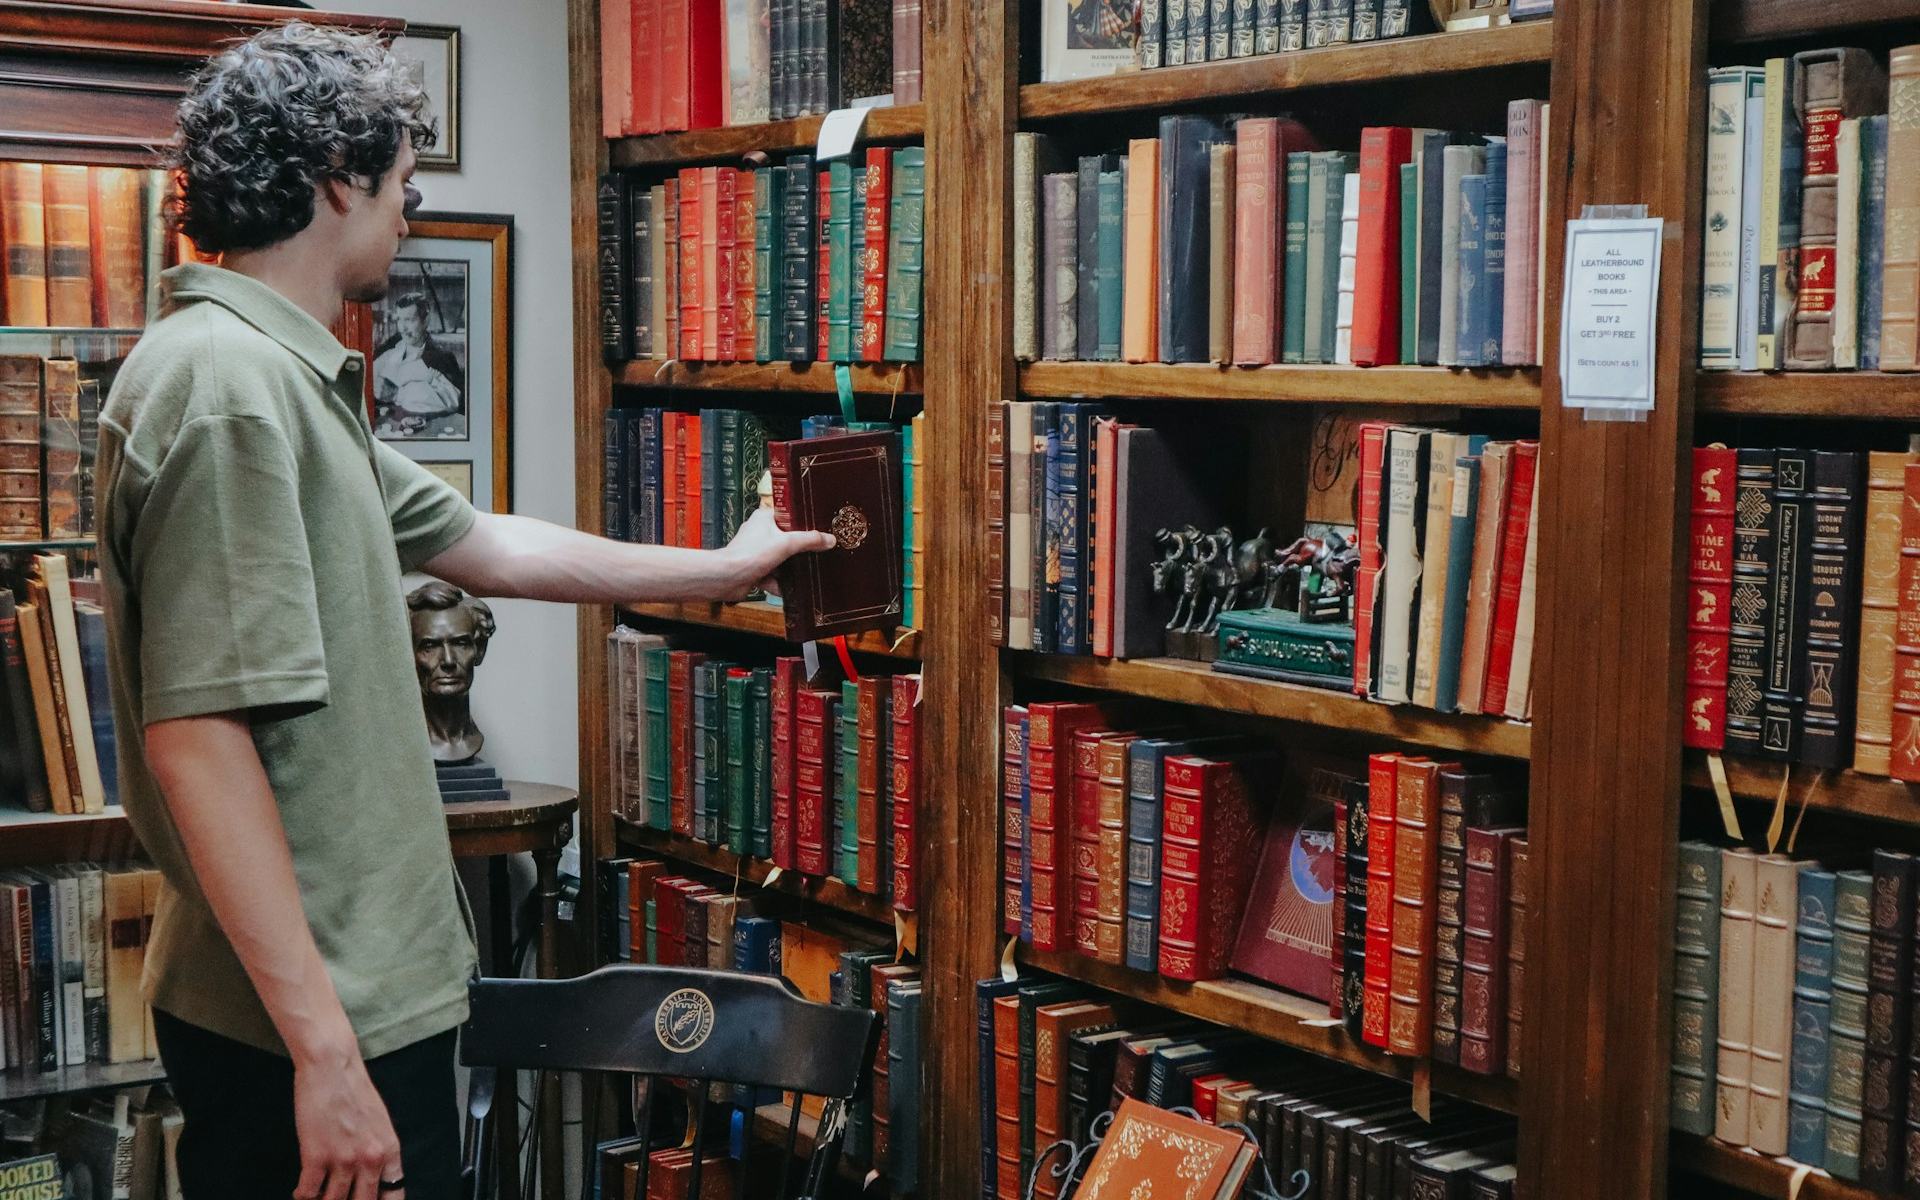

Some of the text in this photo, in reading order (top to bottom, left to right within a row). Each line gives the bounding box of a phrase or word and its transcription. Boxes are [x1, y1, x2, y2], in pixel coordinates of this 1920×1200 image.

[1606, 248, 1621, 256] ALL
[1581, 258, 1645, 268] LEATHERBOUND
[1598, 273, 1626, 281] BOOKS
[1596, 315, 1621, 324] BUY 2
[1581, 330, 1596, 339] GET
[1613, 330, 1636, 339] FREE
[1817, 514, 1842, 524] EUGENE
[1705, 523, 1714, 533] A
[1782, 509, 1793, 544] Zachary
[1818, 525, 1839, 534] LYONS
[1695, 535, 1725, 547] TIME
[1701, 548, 1716, 558] TO
[1780, 545, 1791, 572] Taylor
[1694, 559, 1724, 572] HEAL
[1812, 565, 1843, 575] HERBERT
[1812, 577, 1842, 586] HOOVER
[1779, 575, 1789, 604] Soldier
[1778, 617, 1786, 631] the
[1776, 632, 1786, 658] White
[1774, 660, 1784, 687] House
[65, 905, 77, 927] long
[659, 992, 711, 1043] VANDERBILT UNIVERSITY
